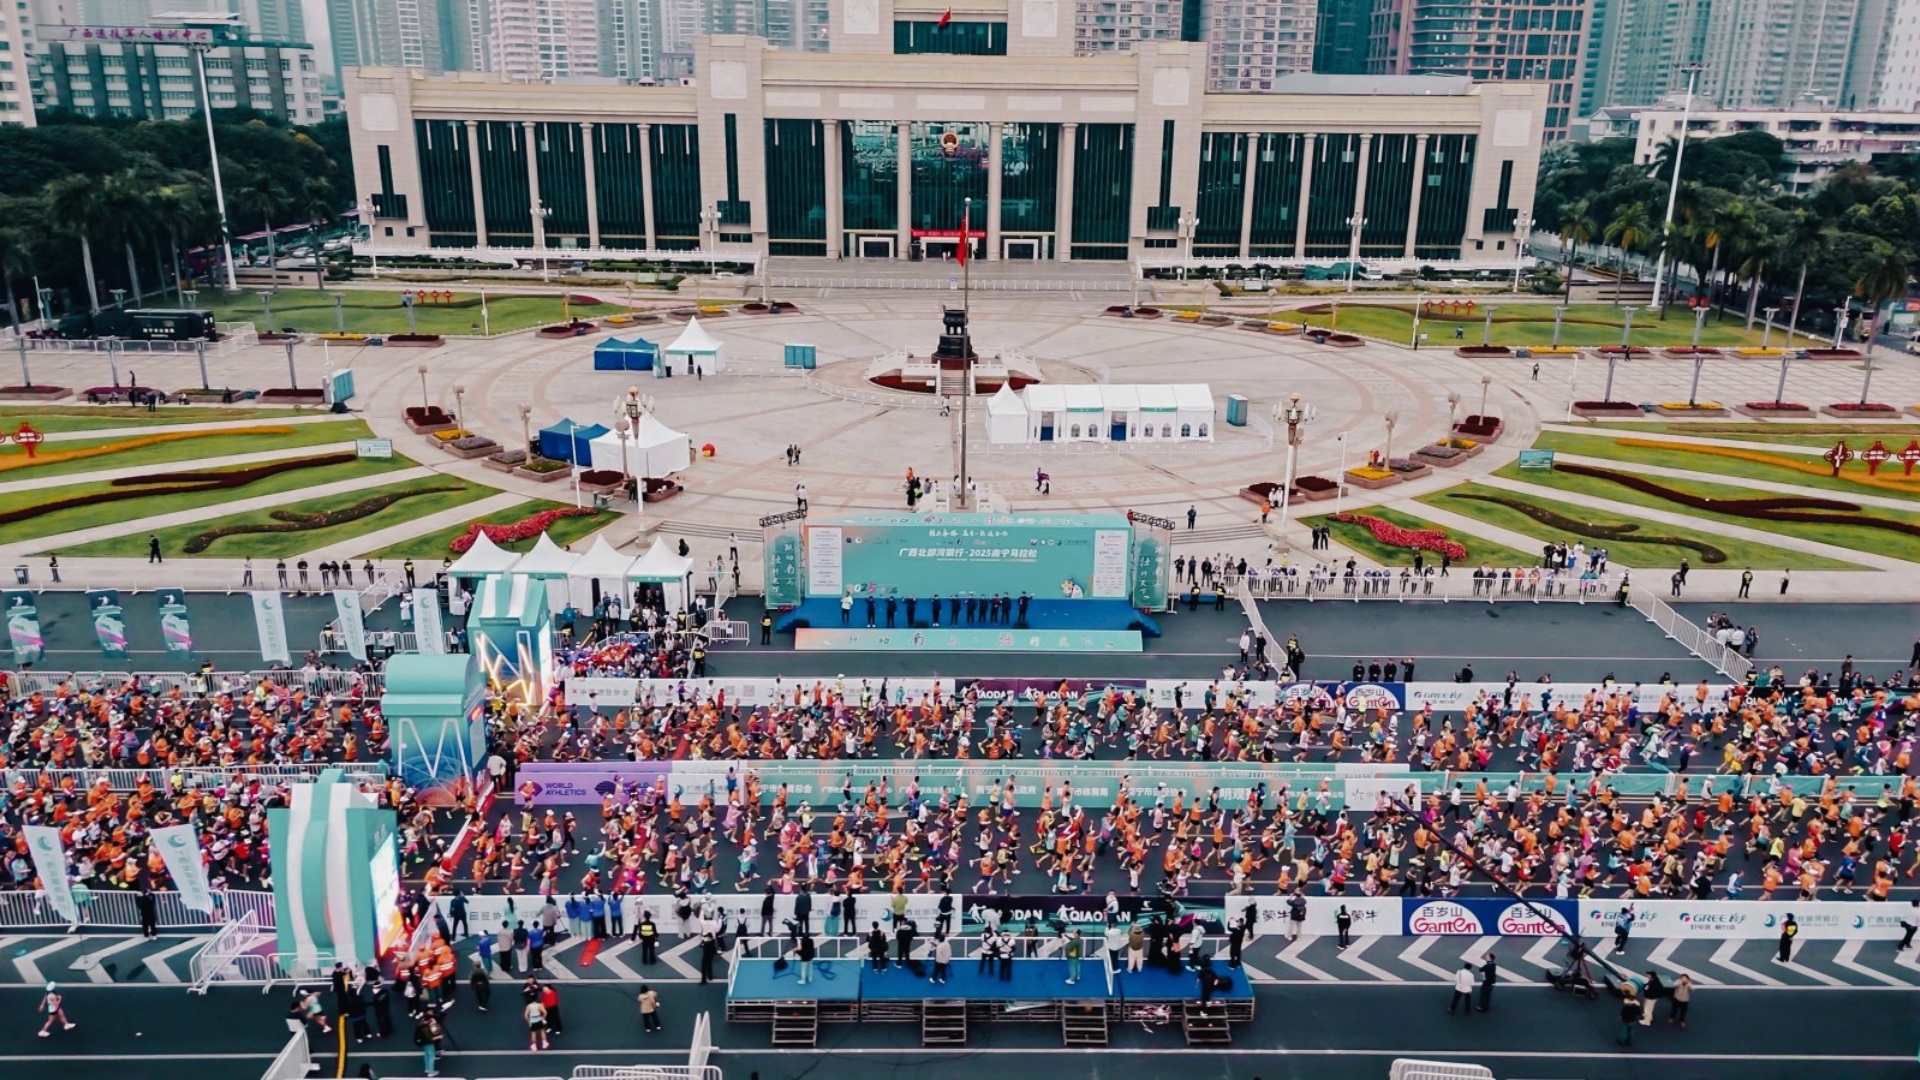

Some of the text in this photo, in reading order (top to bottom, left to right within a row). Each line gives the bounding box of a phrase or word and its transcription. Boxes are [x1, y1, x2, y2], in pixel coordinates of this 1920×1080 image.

[1262, 910, 1290, 923] 蒙牛
[1351, 910, 1379, 923] 蒙牛
[1423, 906, 1463, 917] 百岁山
[1693, 913, 1727, 922] GREE
